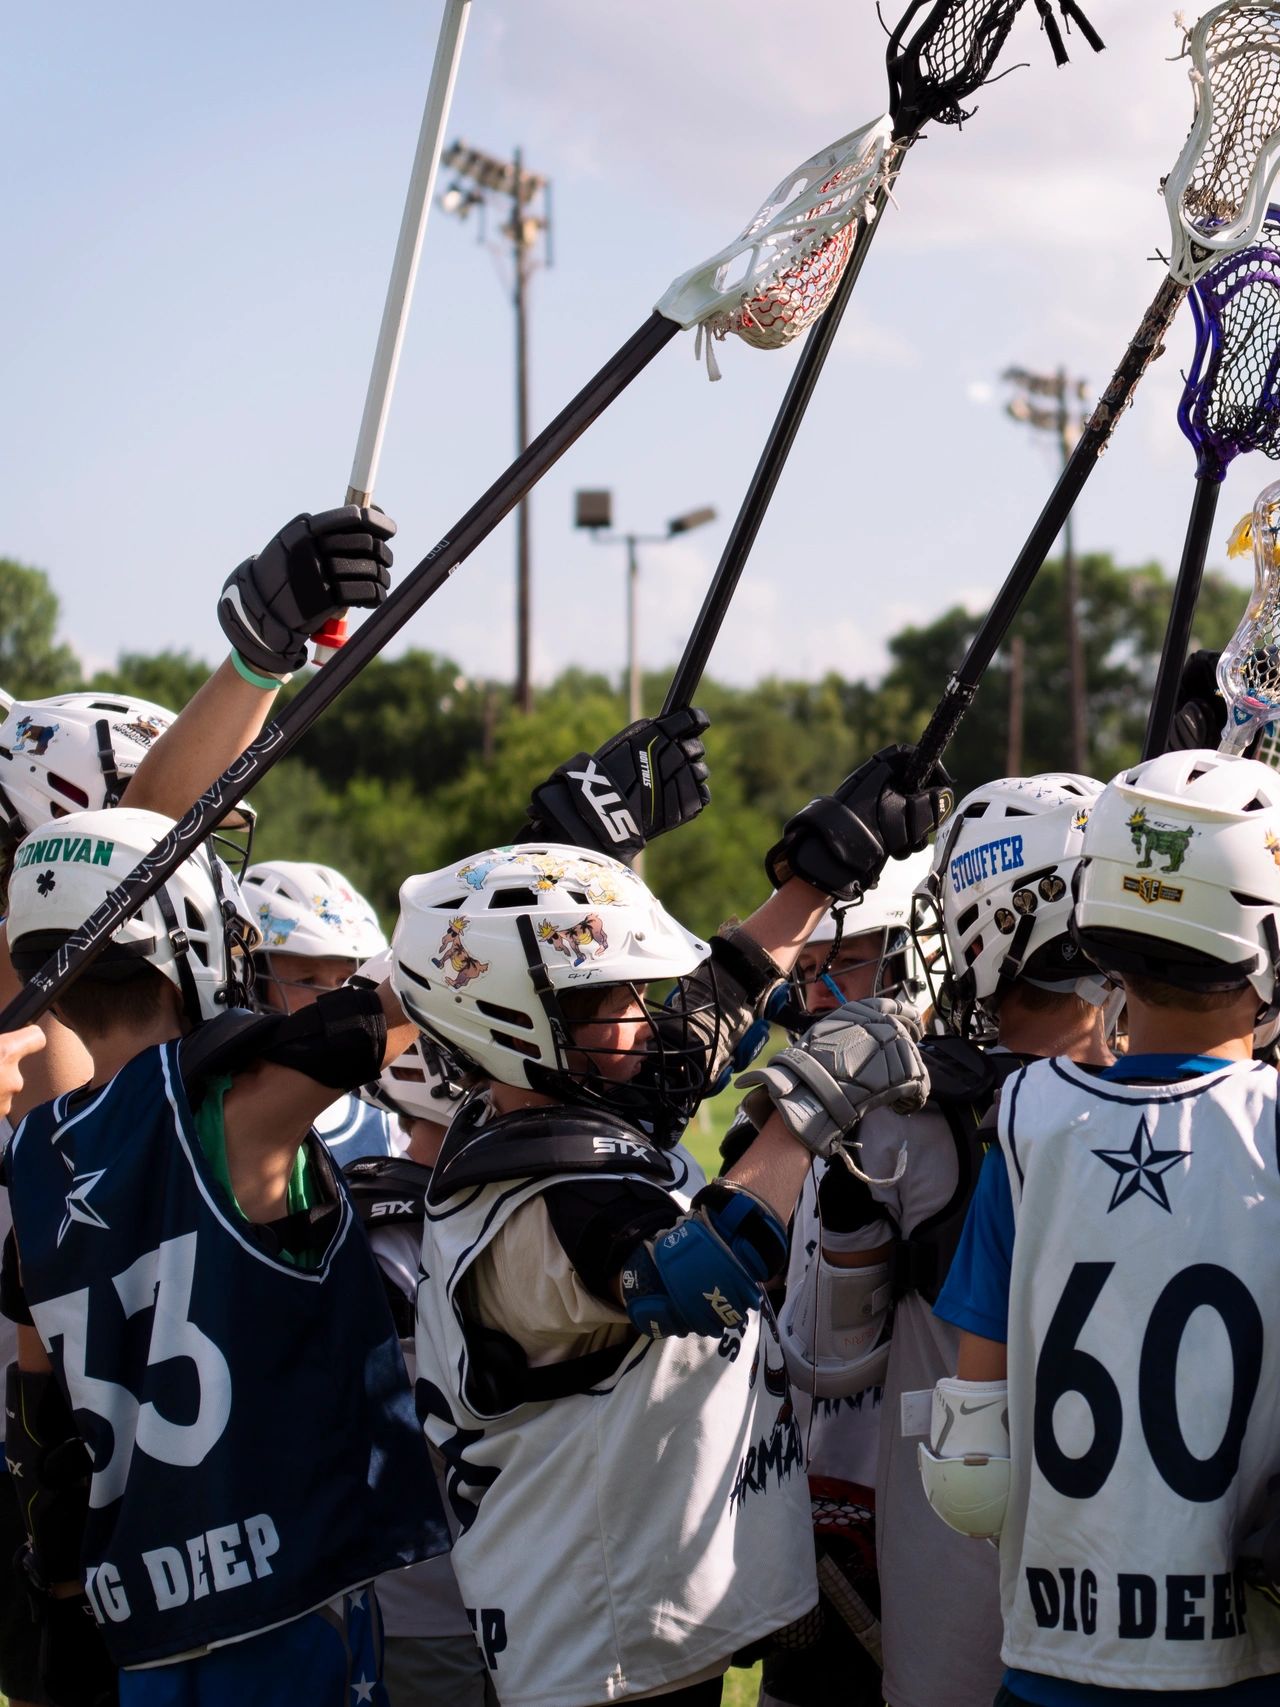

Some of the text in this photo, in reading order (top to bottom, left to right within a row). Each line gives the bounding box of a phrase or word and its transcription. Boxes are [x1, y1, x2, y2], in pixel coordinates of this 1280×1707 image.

[638, 750, 652, 789] STALLION
[566, 759, 641, 843] STX
[950, 834, 1025, 894] STOUFFER
[593, 1137, 651, 1163] STX
[371, 1201, 414, 1217] STX
[702, 1286, 743, 1327] STX
[29, 1231, 231, 1508] 33
[1034, 1261, 1264, 1503] 60
[5, 1456, 24, 1477] TX
[85, 1513, 280, 1625] IG DEEP
[1025, 1567, 1097, 1636] DIG
